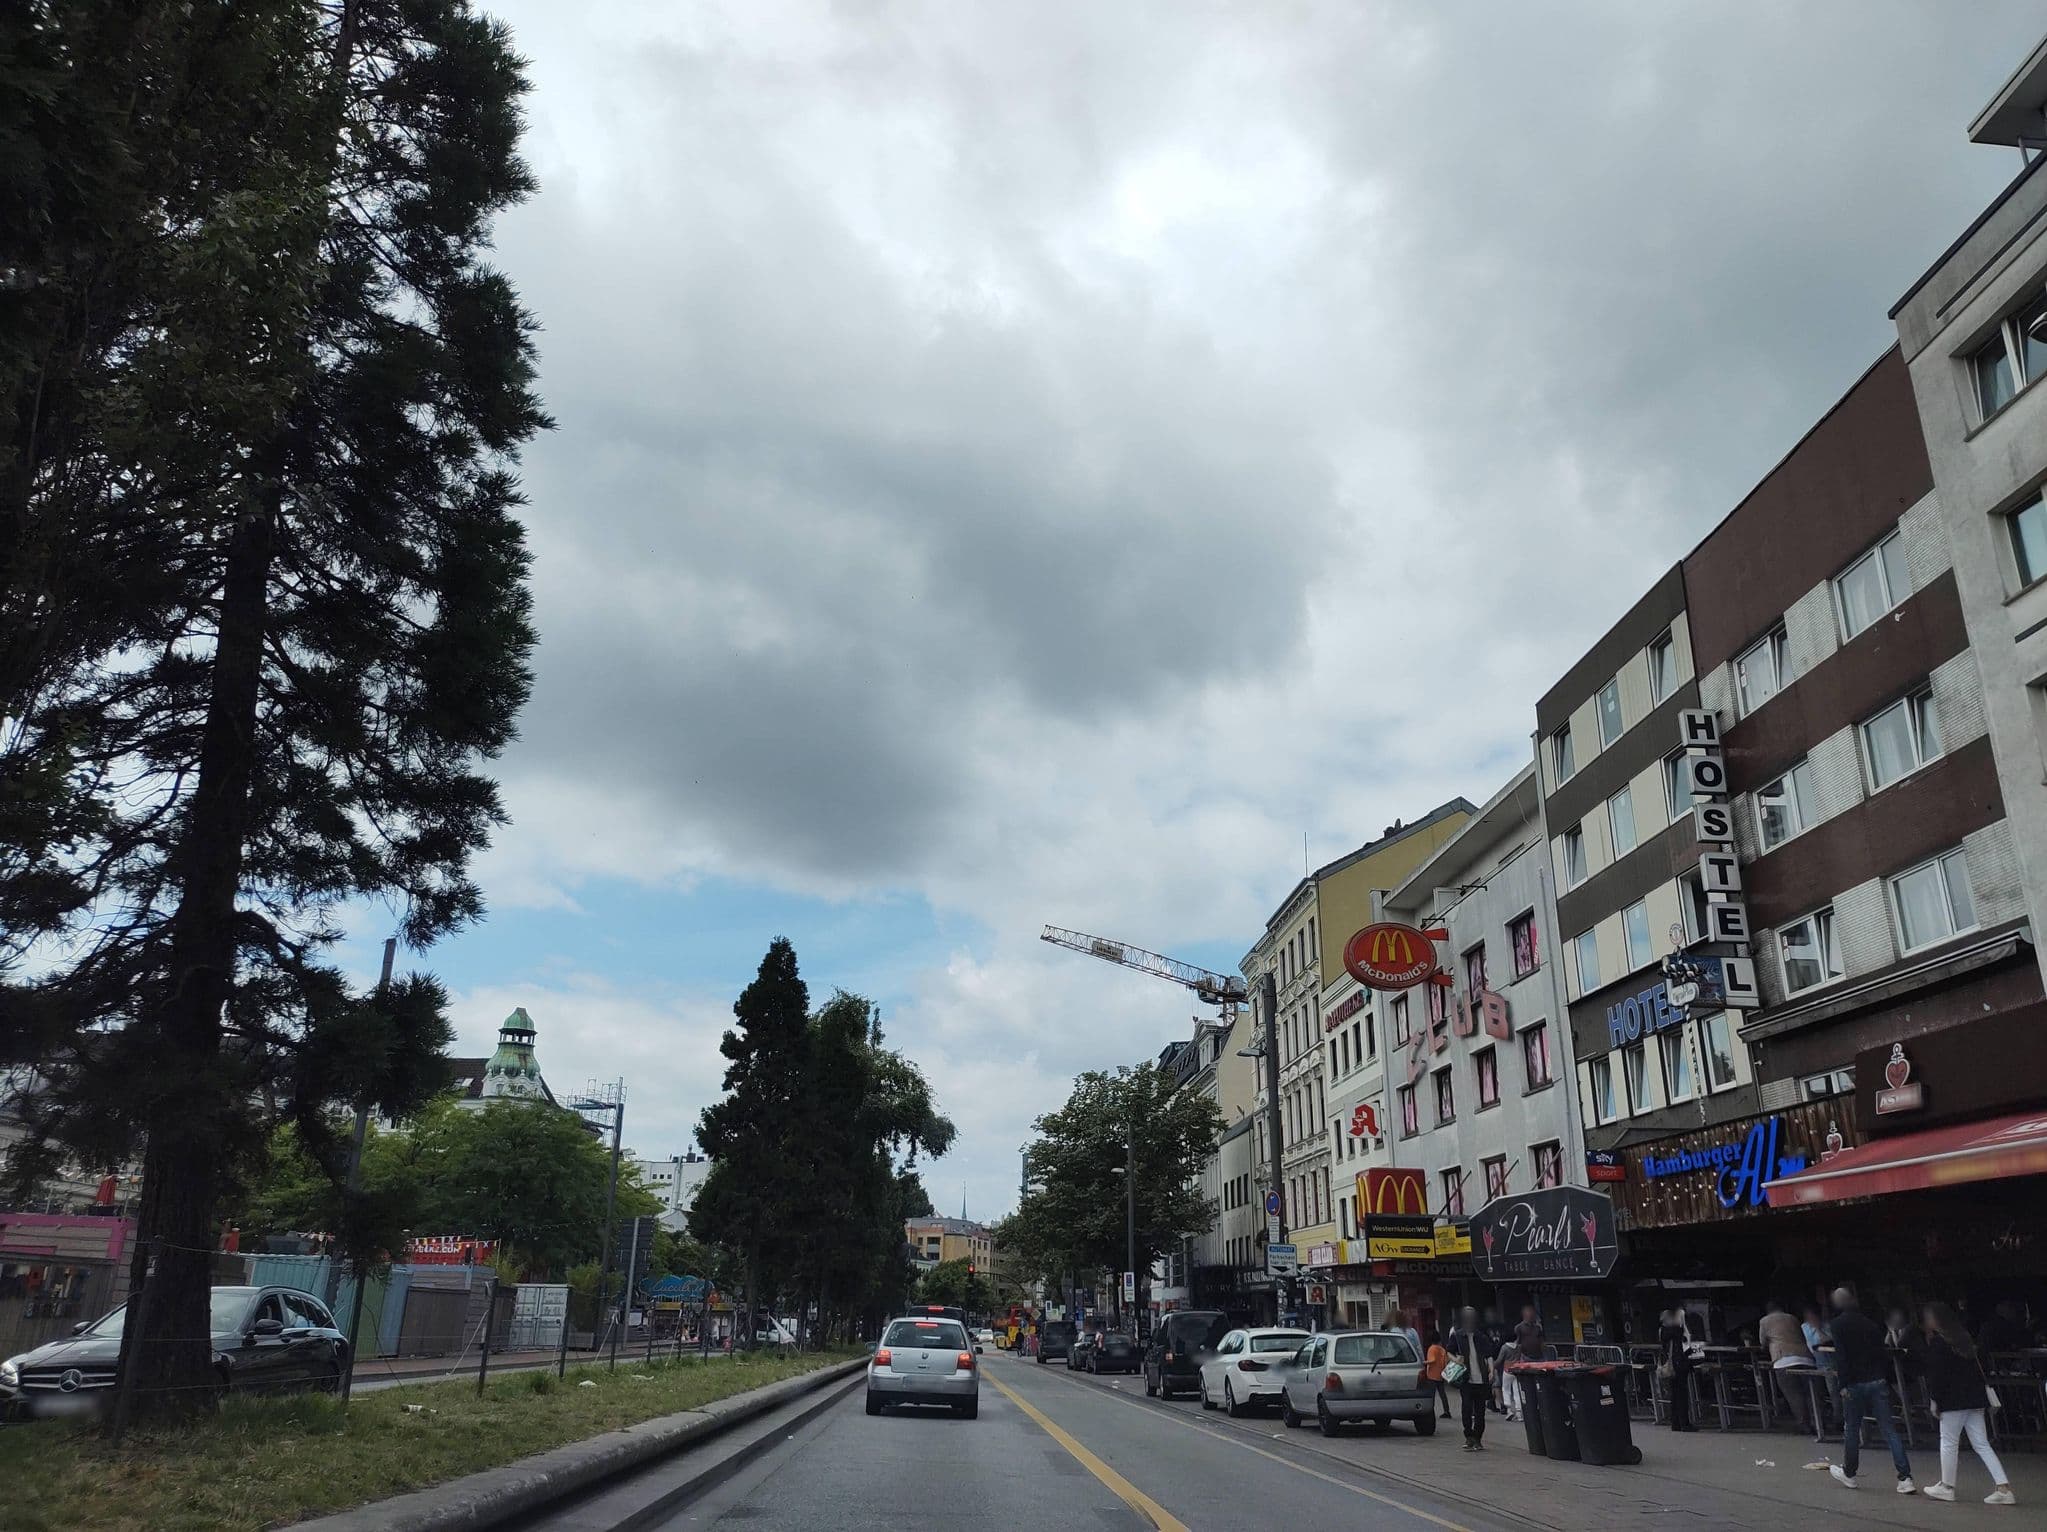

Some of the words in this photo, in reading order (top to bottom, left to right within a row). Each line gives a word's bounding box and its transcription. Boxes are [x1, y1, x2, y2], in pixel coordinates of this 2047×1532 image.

[1686, 713, 1753, 992] HOSTEL
[1357, 959, 1429, 982] McDonald's
[1406, 982, 1509, 1086] CLUB
[1595, 1152, 1614, 1165] sky
[1597, 1168, 1618, 1178] sport
[1642, 1140, 1744, 1179] Hamburger
[1499, 1202, 1572, 1254] Pearls
